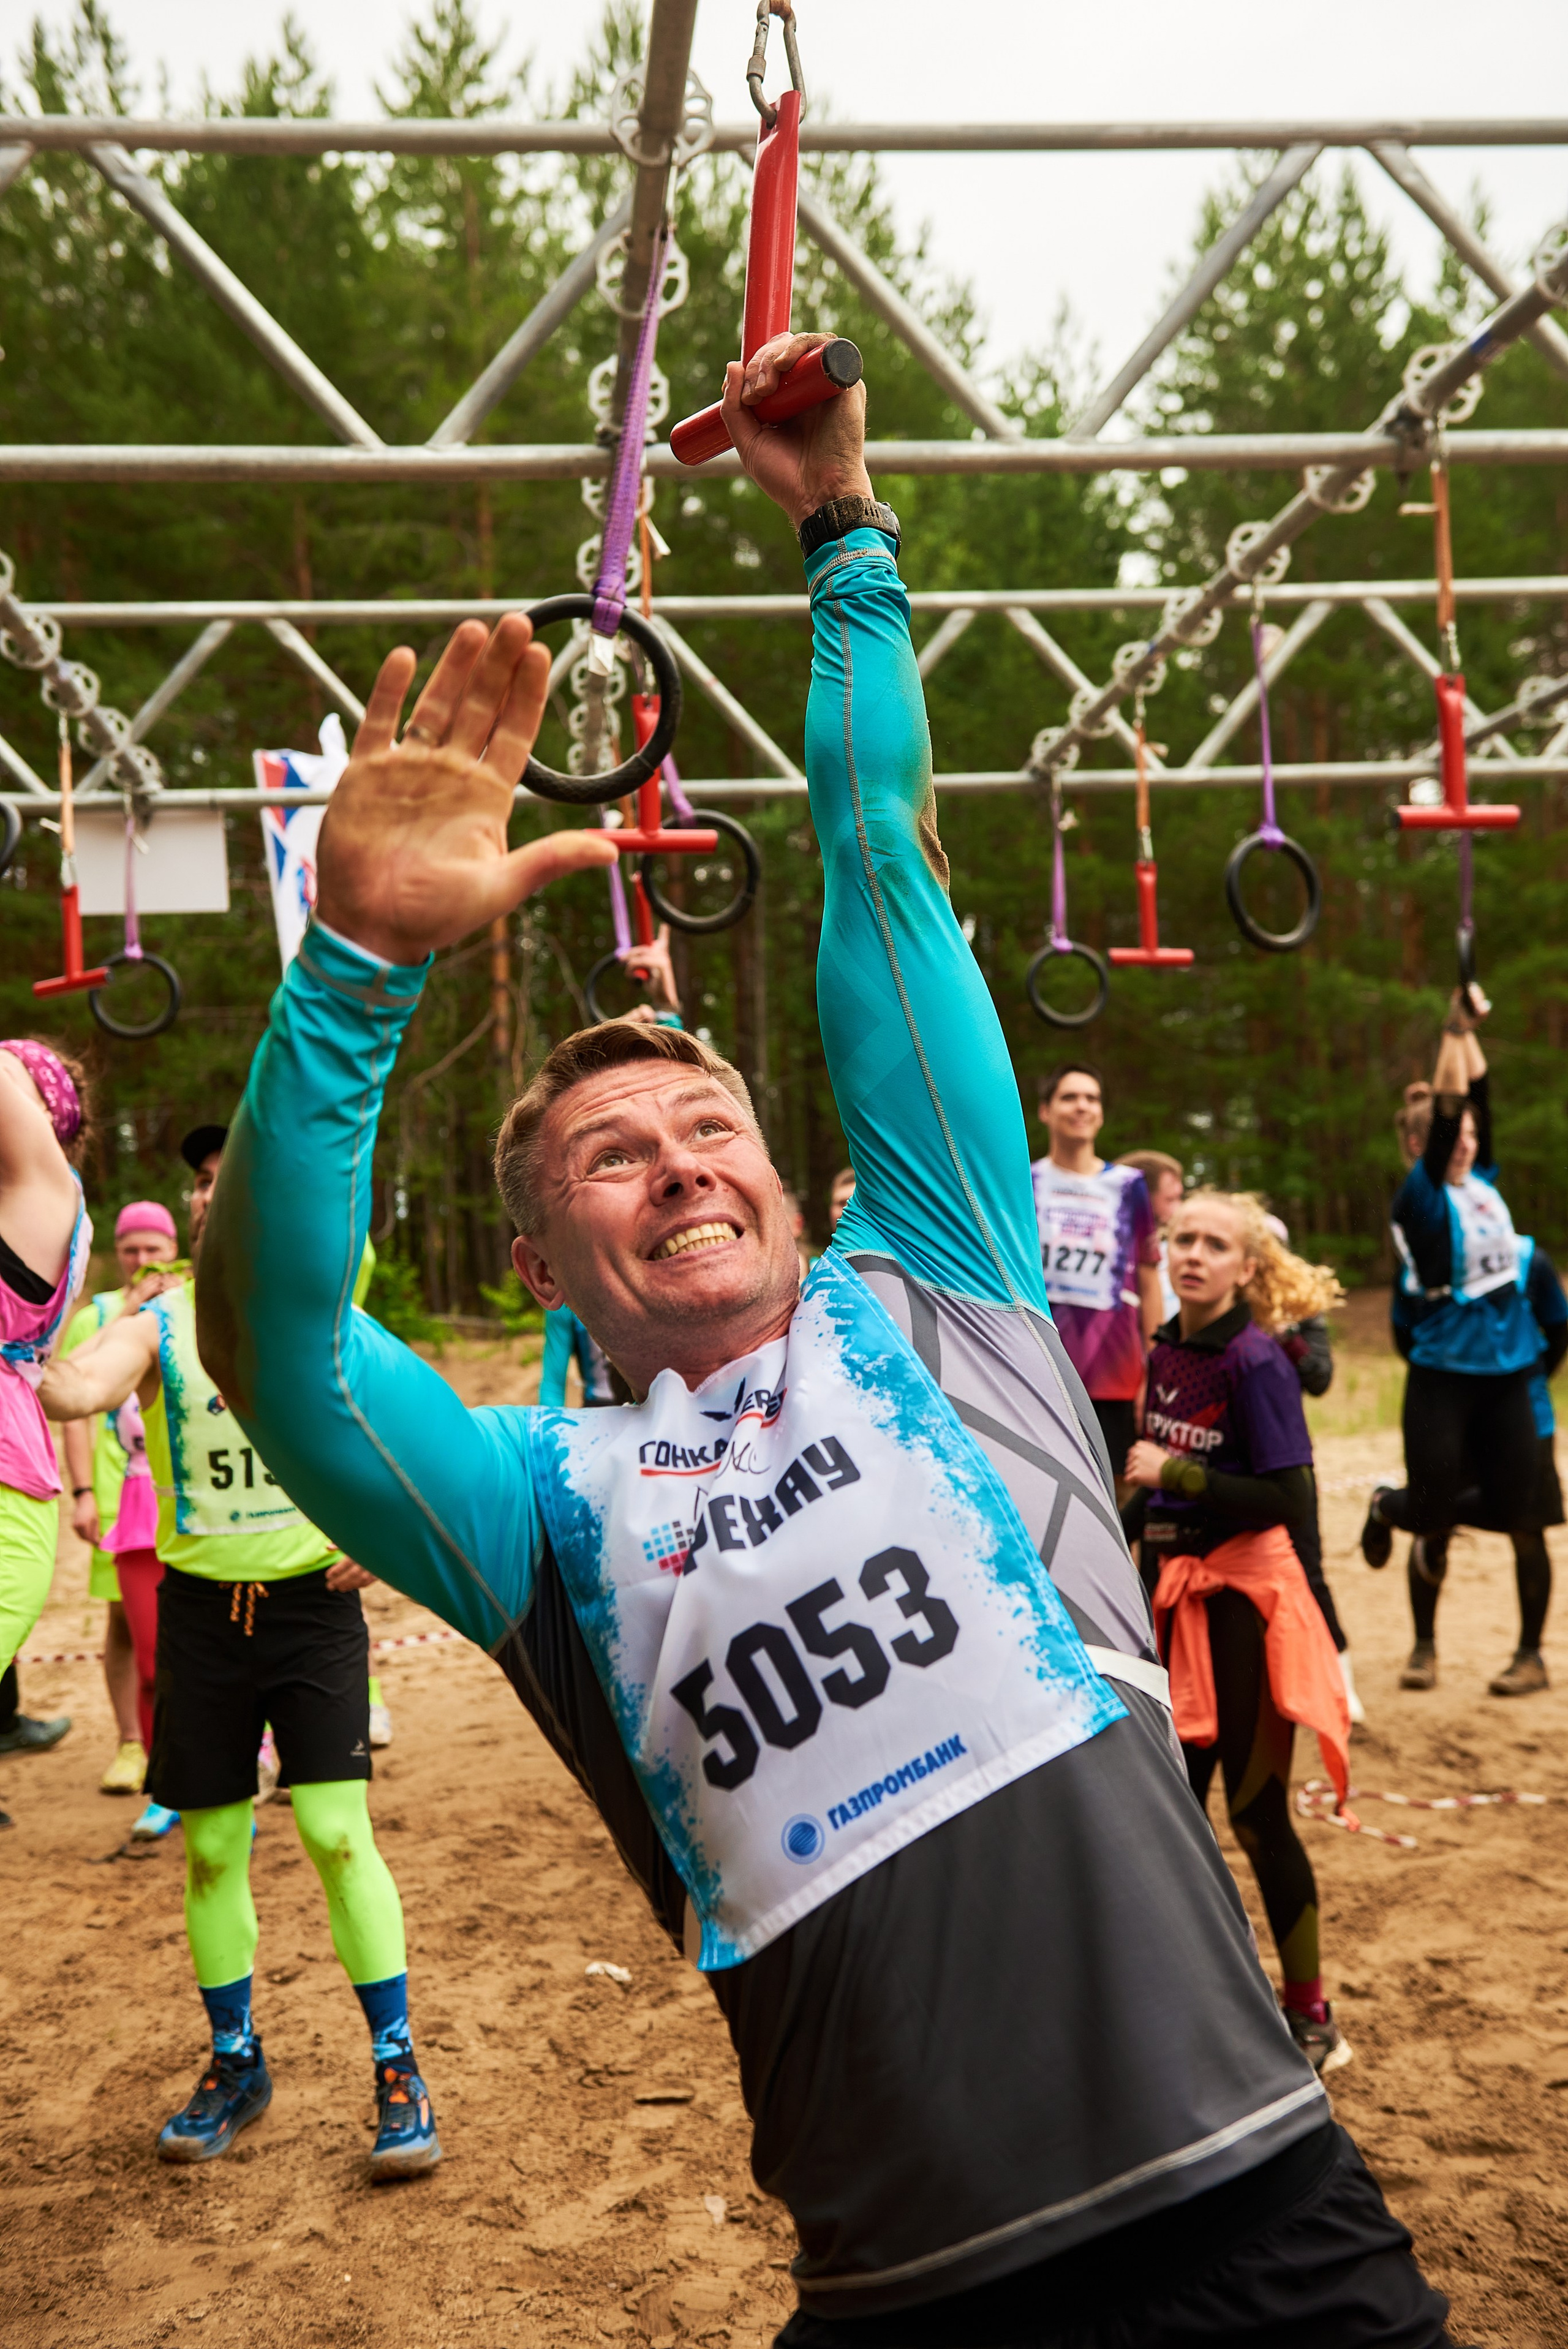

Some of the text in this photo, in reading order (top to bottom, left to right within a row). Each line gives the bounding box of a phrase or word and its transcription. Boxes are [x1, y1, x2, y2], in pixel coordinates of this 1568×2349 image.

[208, 1447, 276, 1490] 51
[639, 1438, 729, 1468] ГОНКА
[669, 1546, 960, 1792] 5053
[827, 1734, 967, 1830] ГАЗПРОМБАНК
